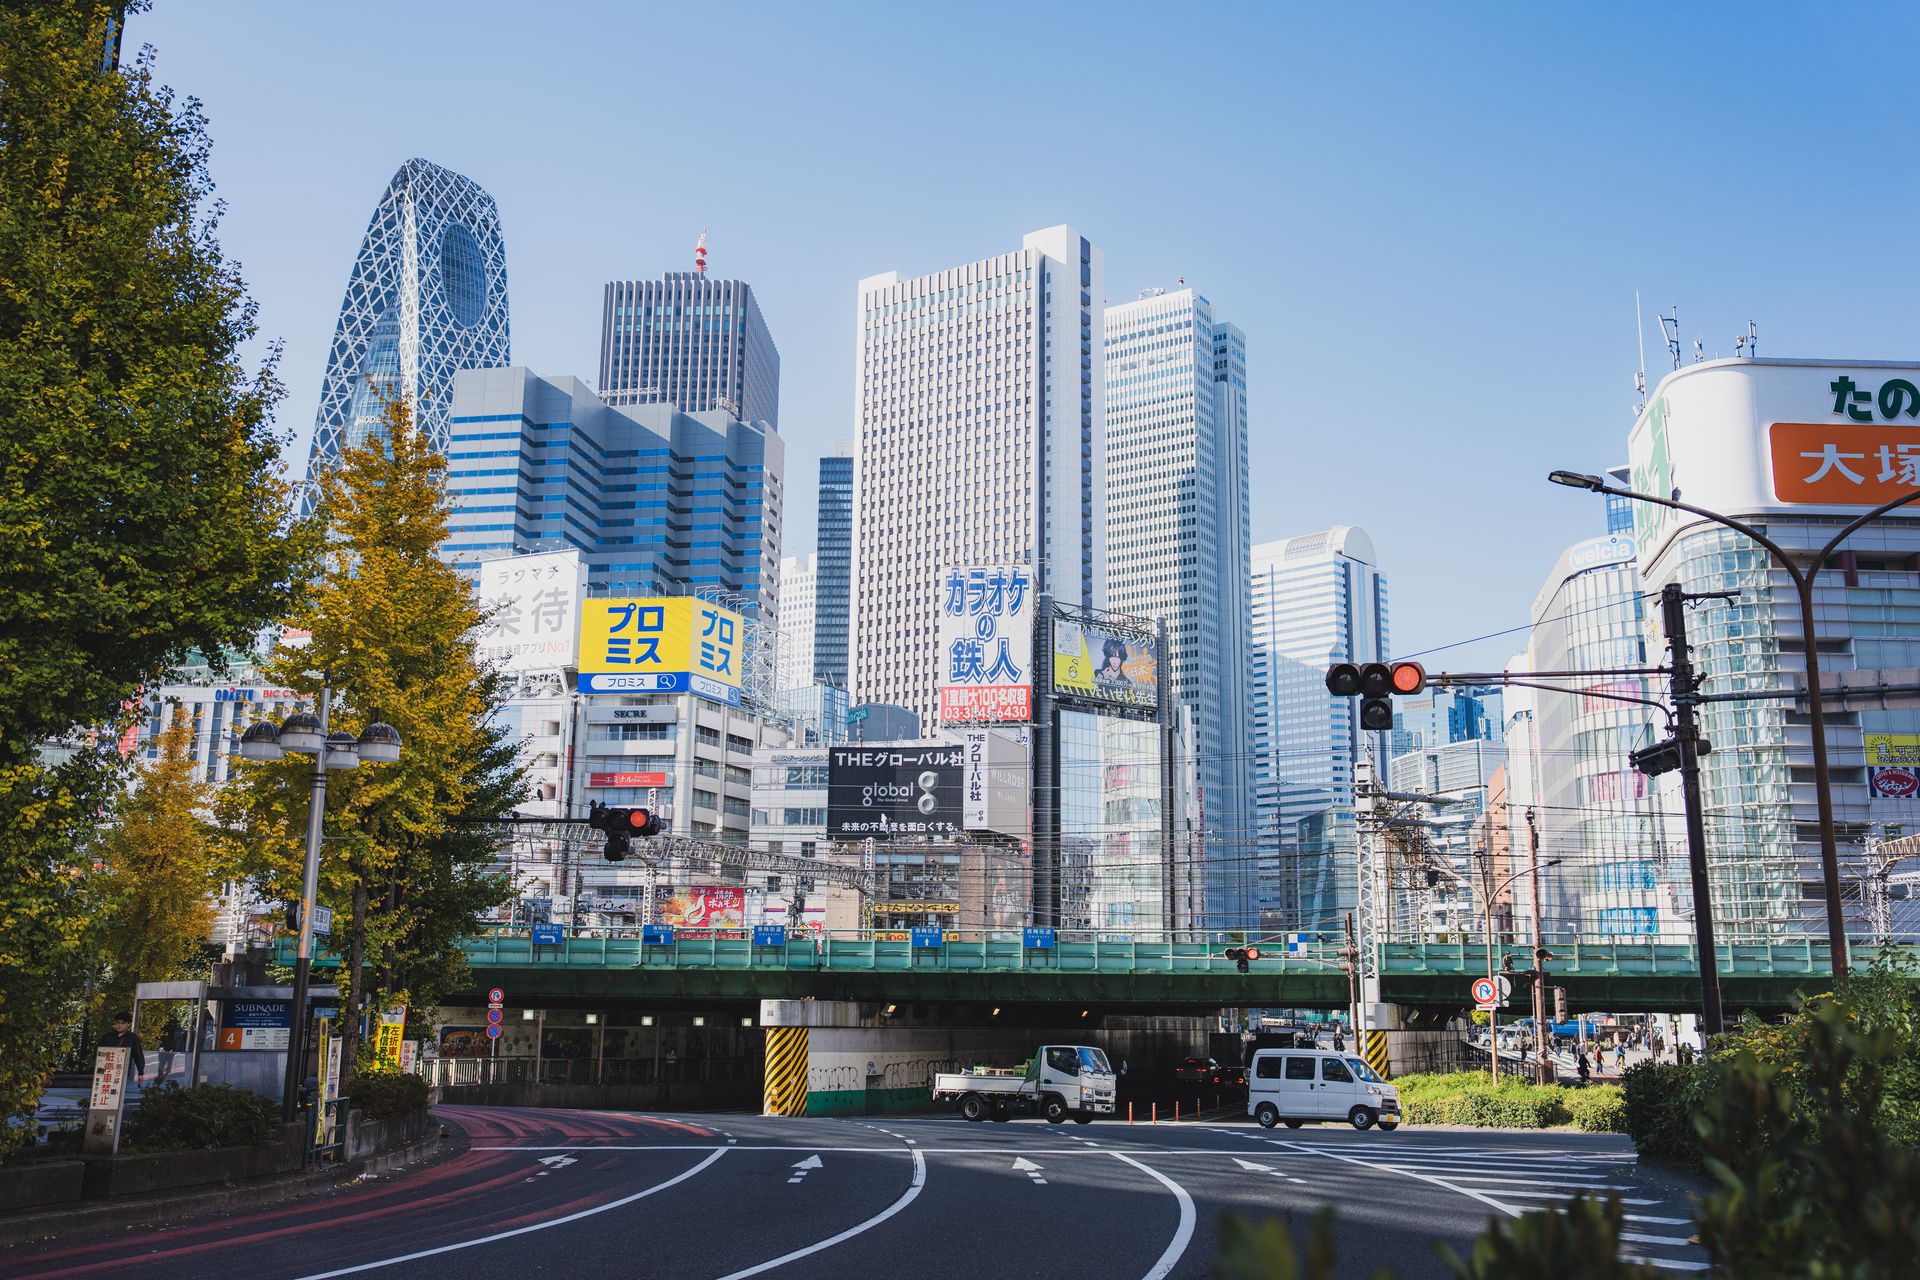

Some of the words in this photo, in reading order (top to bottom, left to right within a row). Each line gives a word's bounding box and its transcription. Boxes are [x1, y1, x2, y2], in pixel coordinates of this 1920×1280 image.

[1573, 537, 1632, 564] welcia
[944, 566, 1030, 617] カラオケ
[484, 586, 569, 638] 楽待
[608, 602, 664, 633] プロ
[701, 610, 734, 646] プロ
[975, 611, 997, 642] の
[605, 637, 663, 664] ミス
[700, 641, 732, 676] ミス
[949, 637, 1023, 684] 鉄人
[263, 689, 280, 698] BIC
[608, 677, 646, 687] プロミス
[700, 680, 723, 696] プロミス
[944, 688, 1027, 706] 1室最大100名収容
[614, 710, 648, 718] SECRE
[967, 734, 986, 742] THE
[835, 752, 964, 768] THEグローバル社
[969, 743, 983, 801] グローバル社
[862, 781, 914, 807] global
[234, 1003, 286, 1013] SUBNADE
[226, 1032, 236, 1045] 4
[99, 1051, 115, 1106] 駐停車禁止
